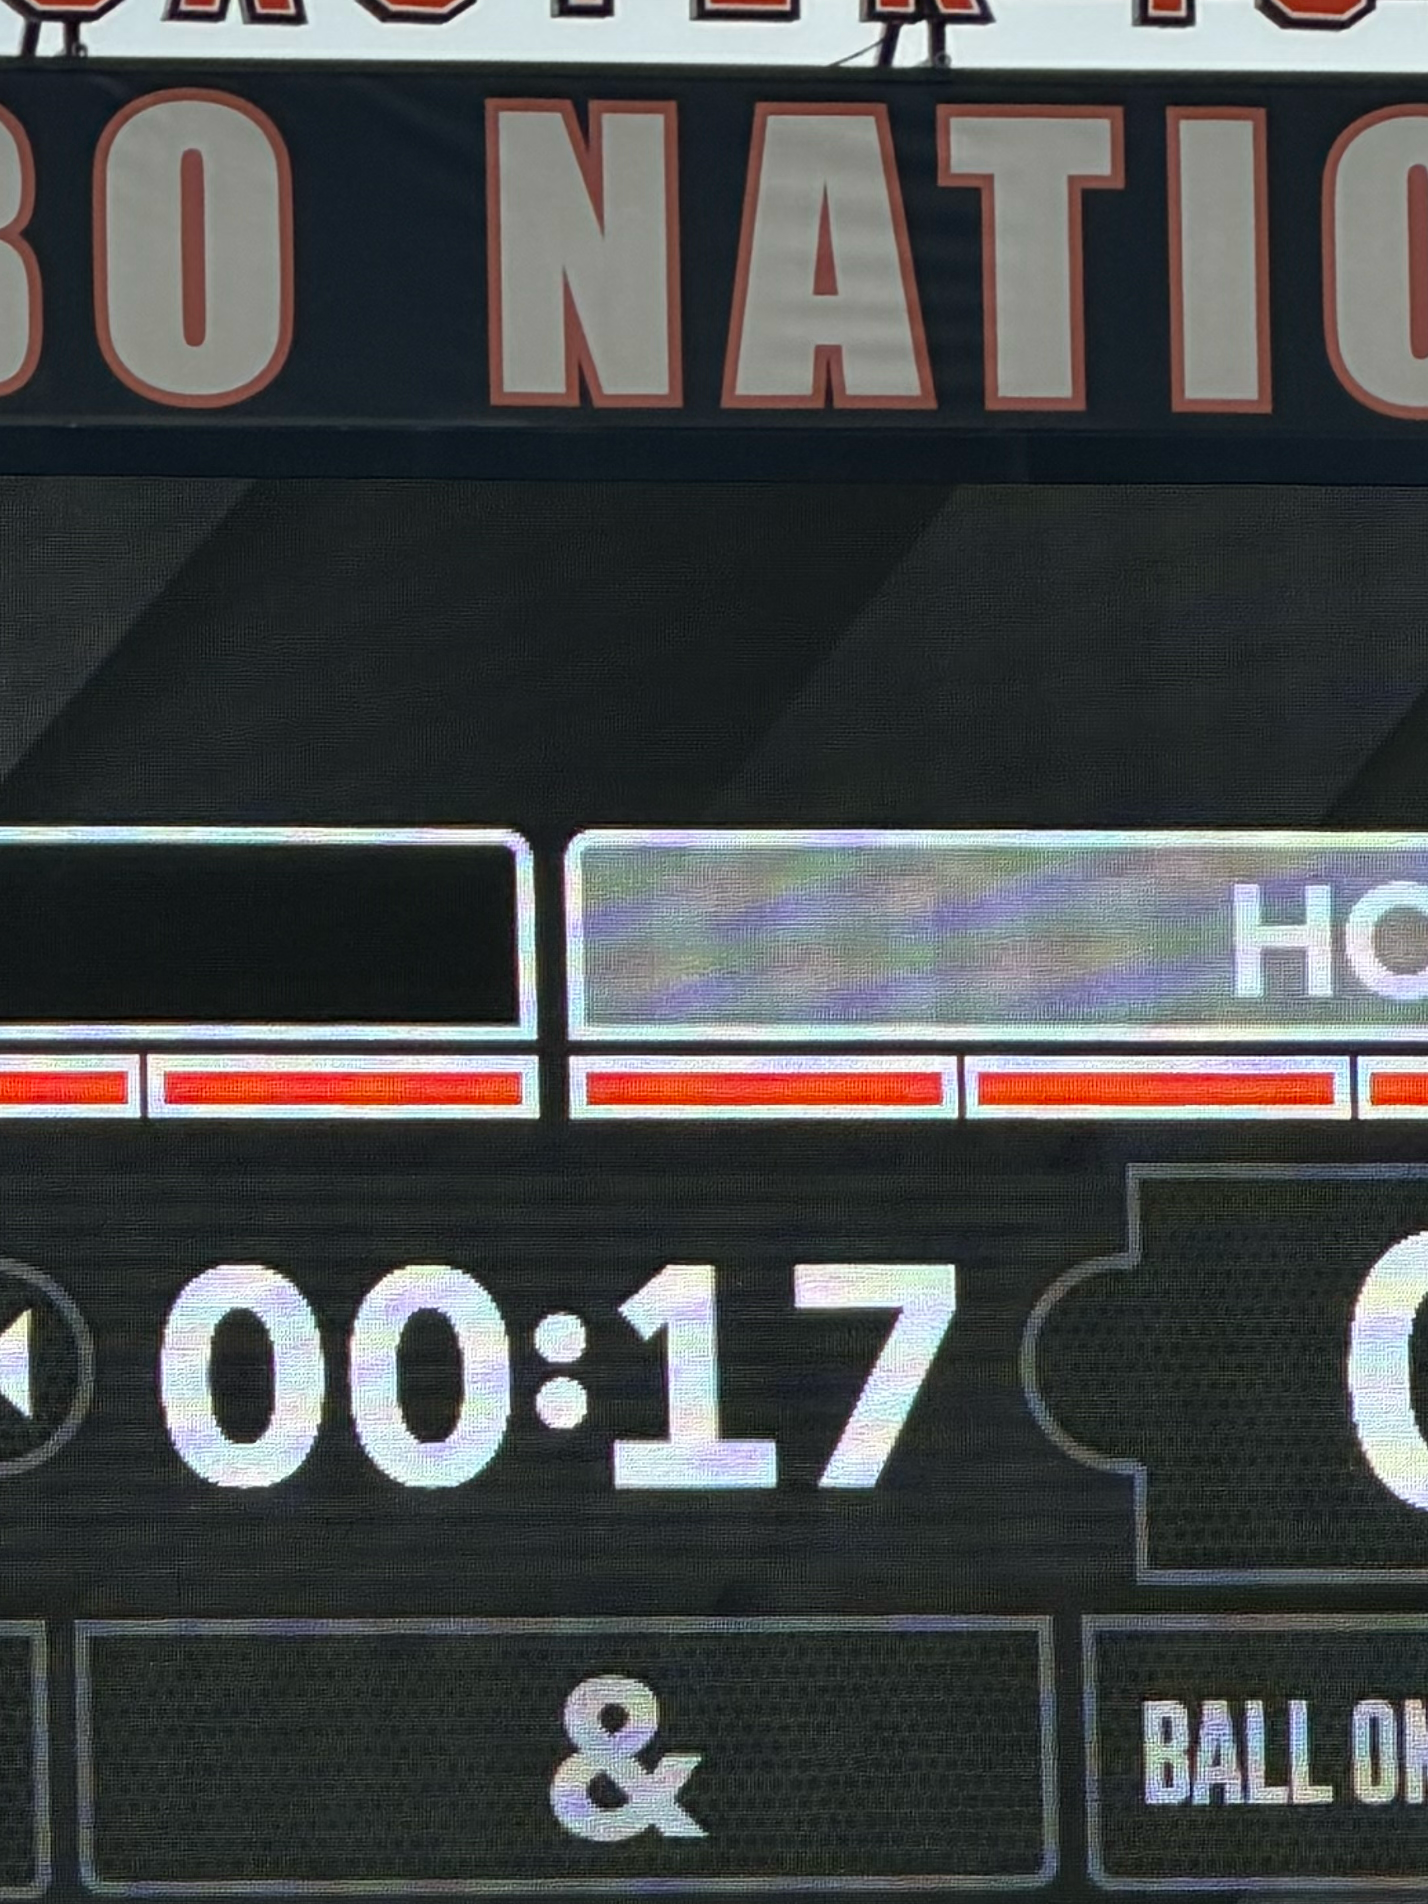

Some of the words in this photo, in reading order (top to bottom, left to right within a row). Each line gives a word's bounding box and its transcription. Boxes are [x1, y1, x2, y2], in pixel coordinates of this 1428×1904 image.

[160, 1263, 958, 1490] 00:17
[549, 1673, 710, 1843] &
[1139, 1698, 1334, 1807] BALL
